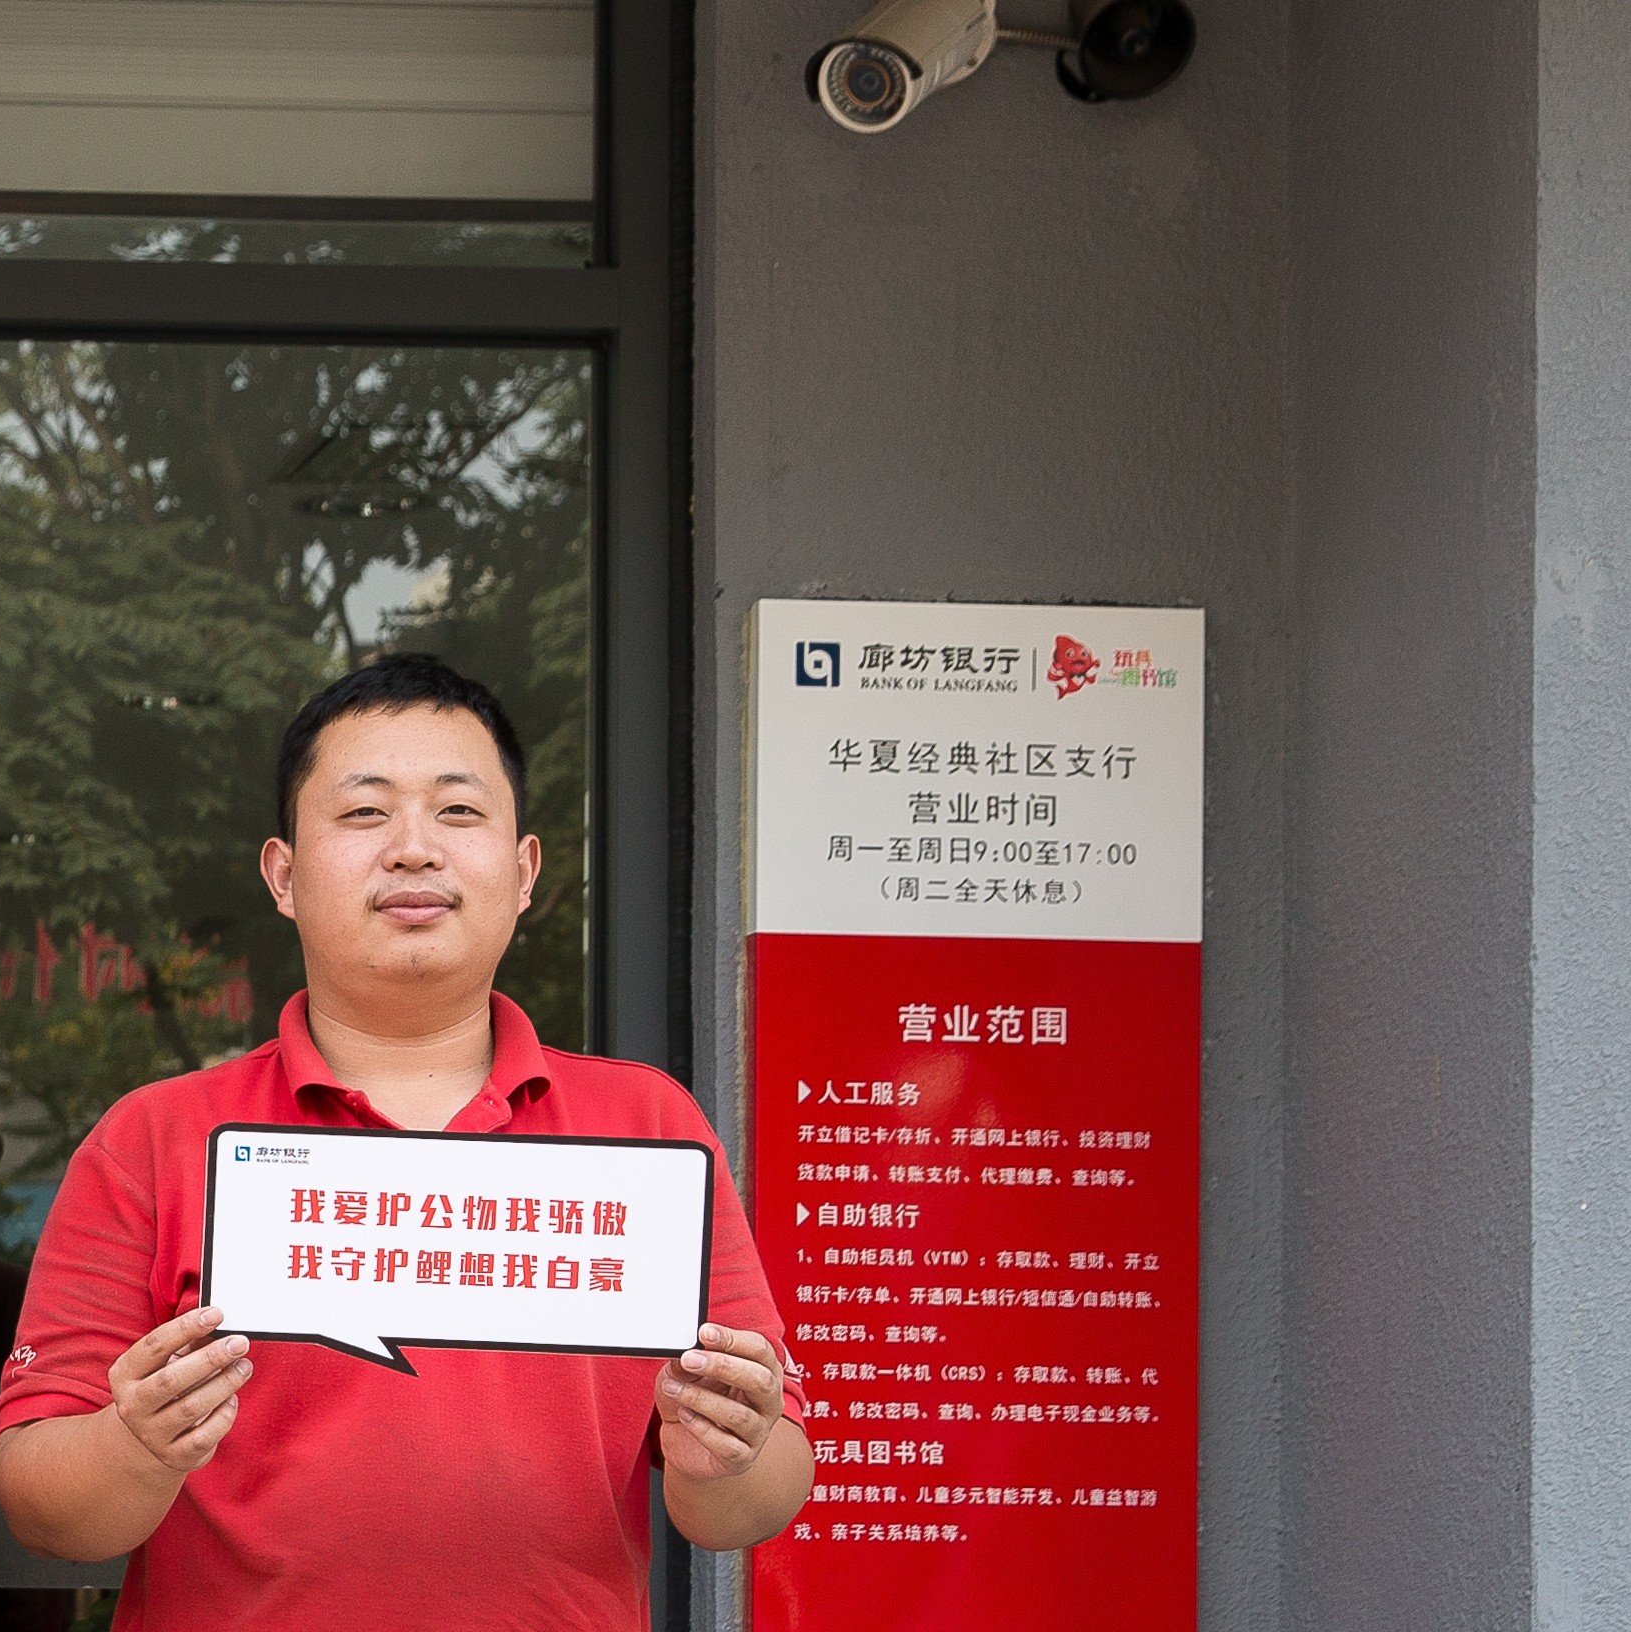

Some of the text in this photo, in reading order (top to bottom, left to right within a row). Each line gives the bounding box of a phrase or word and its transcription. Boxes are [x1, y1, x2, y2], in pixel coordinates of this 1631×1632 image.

[857, 642, 1020, 675] 廊坊银行
[860, 677, 1019, 693] BANK OF LANGFANG
[828, 738, 1137, 780] 华夏经典社区支行
[908, 792, 1057, 827] 营业时间
[826, 835, 1137, 867] 周一至周日9:00至17:00
[898, 1003, 1068, 1046] 营业范围
[818, 1080, 921, 1107] 人工服务
[256, 1146, 310, 1158] 廊坊银行
[289, 1188, 627, 1238] 我爱护公物我骄傲
[817, 1202, 920, 1229] 自助银行
[287, 1244, 624, 1293] 我守护鲤想我自豪
[814, 1440, 945, 1466] 玩具图书馆
[806, 1486, 1158, 1507] 童财商教育、儿童多元智能开发、儿童益智游
